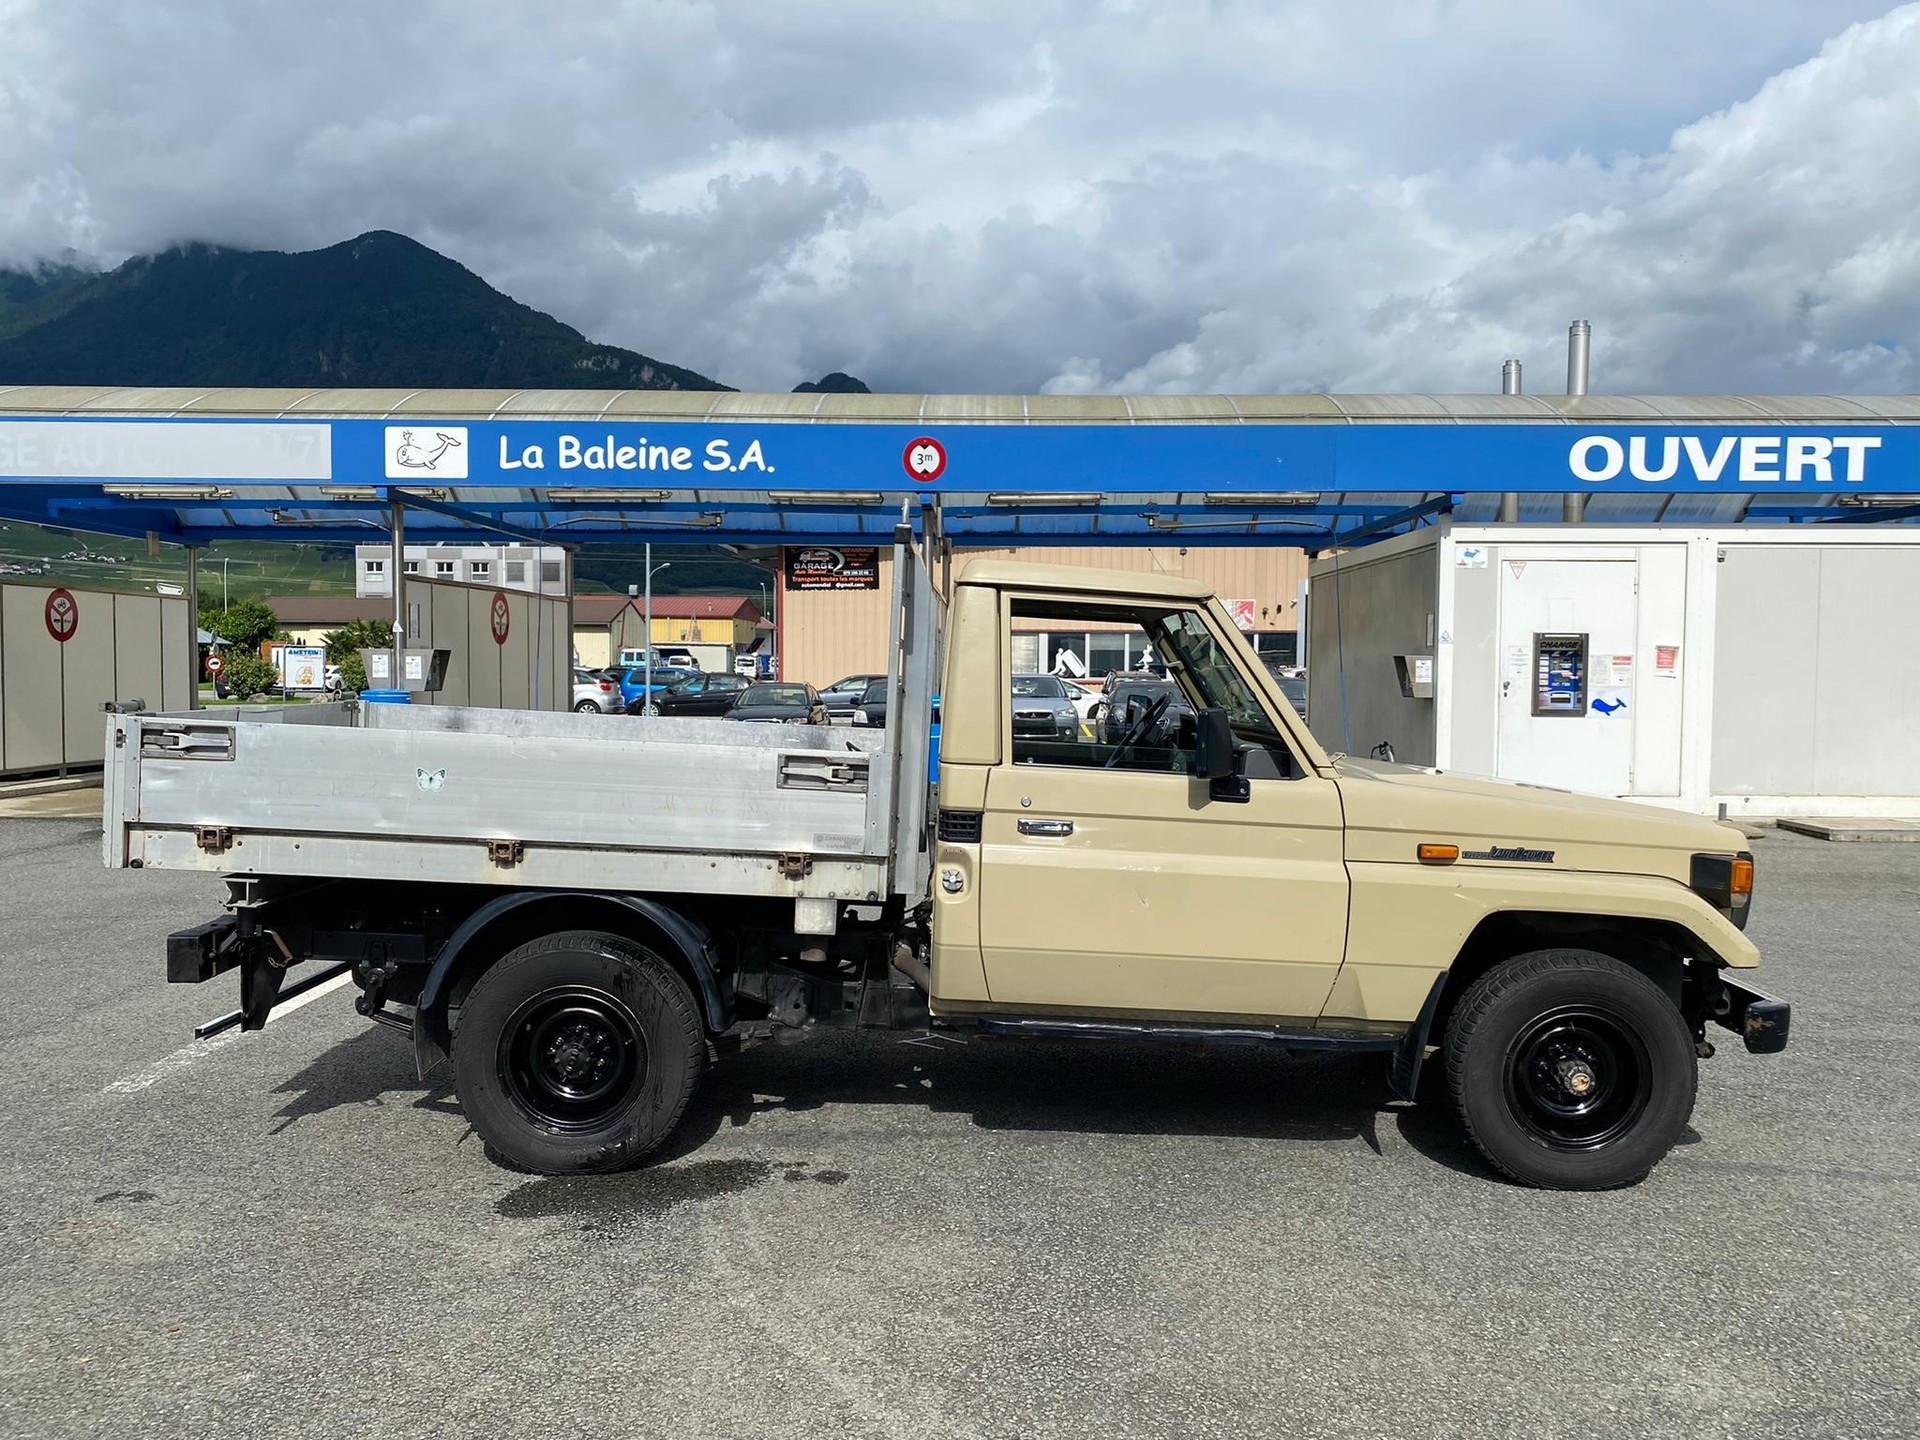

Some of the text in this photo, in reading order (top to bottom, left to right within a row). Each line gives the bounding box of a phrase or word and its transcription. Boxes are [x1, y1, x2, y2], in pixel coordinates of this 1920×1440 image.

[499, 434, 776, 473] La Baleine S.A.
[1568, 435, 1883, 482] OUVERT
[793, 562, 834, 570] GARAGE
[1540, 641, 1579, 649] CHANGE
